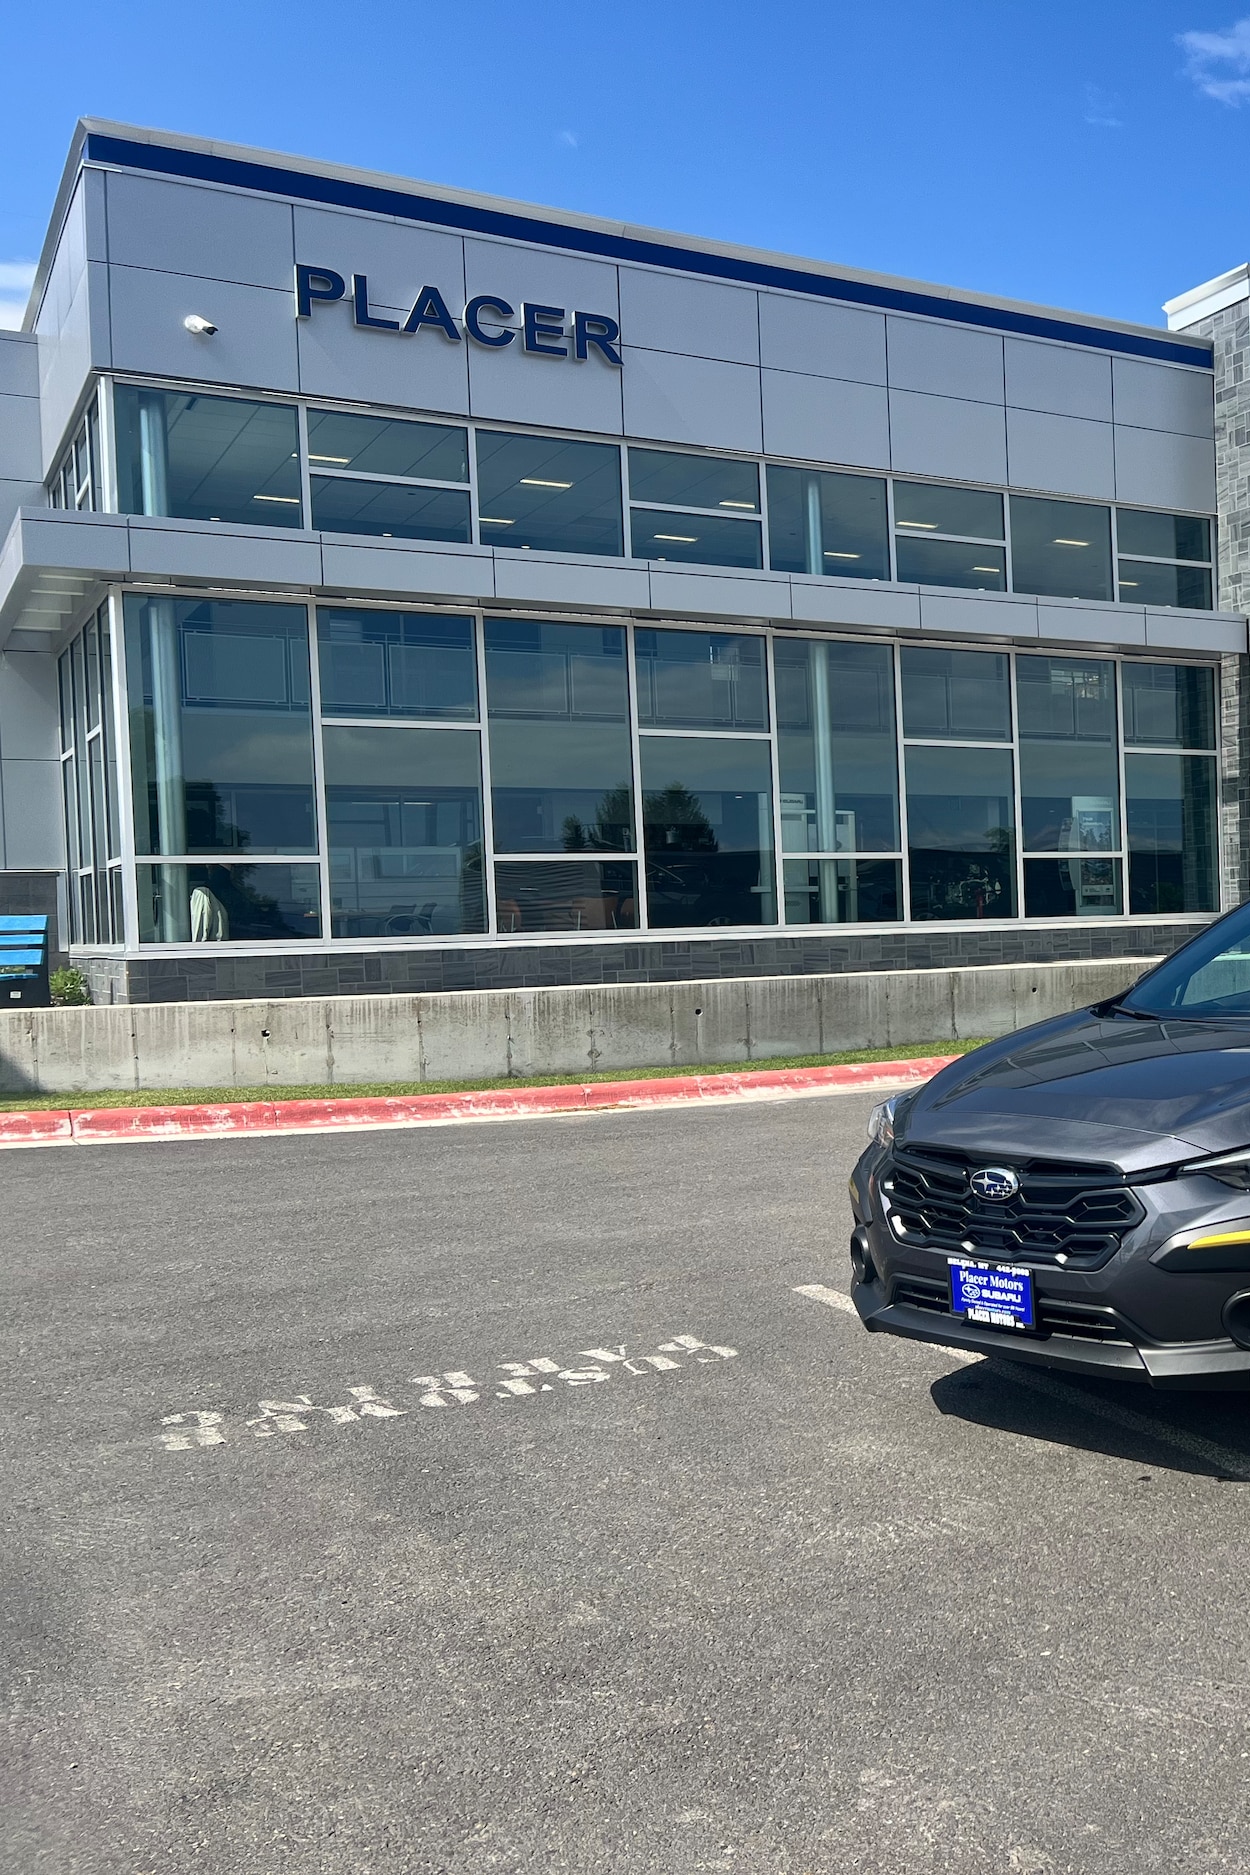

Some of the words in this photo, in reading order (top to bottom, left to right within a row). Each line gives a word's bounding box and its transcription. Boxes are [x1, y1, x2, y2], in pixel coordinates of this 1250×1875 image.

[294, 263, 625, 367] PLACER
[959, 1270, 988, 1286] Placer
[989, 1275, 1024, 1292] Motors
[981, 1288, 1021, 1303] SUBARU
